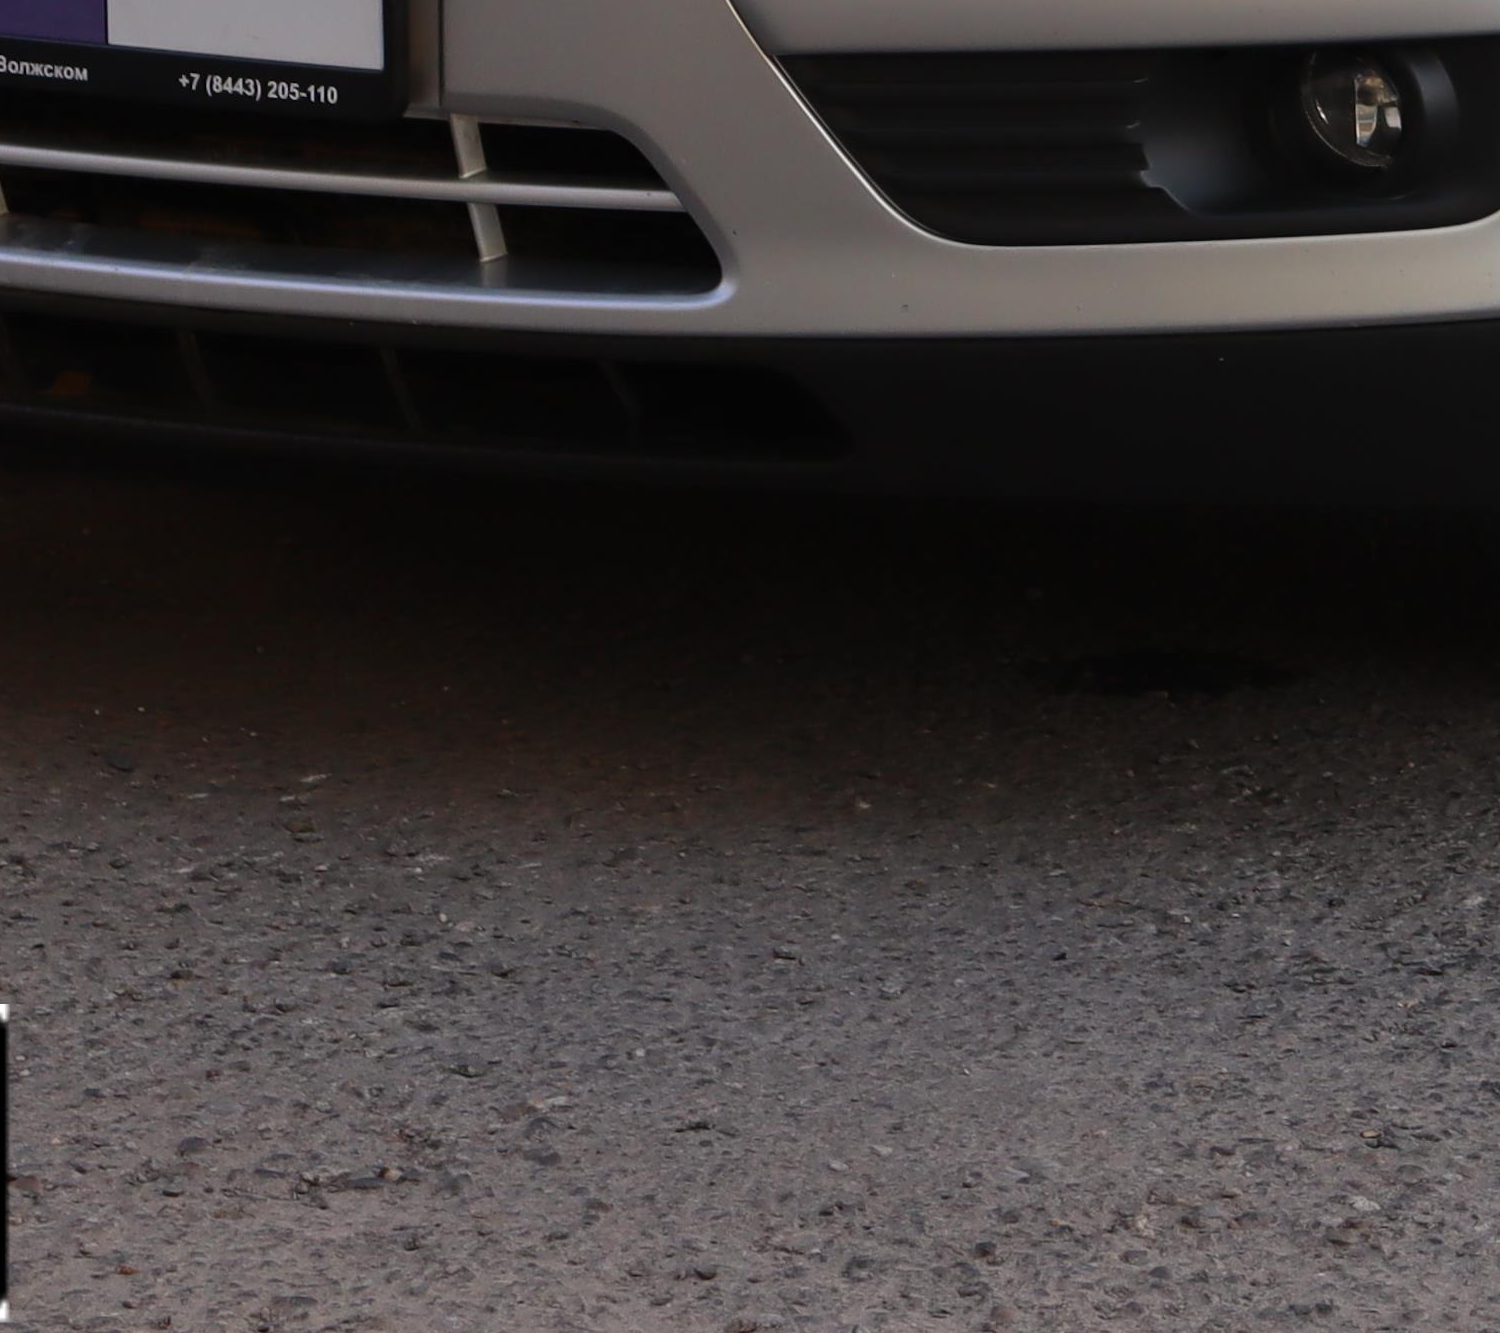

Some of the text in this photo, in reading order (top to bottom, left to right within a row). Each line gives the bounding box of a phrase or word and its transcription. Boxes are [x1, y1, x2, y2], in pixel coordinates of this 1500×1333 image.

[178, 73, 338, 104] +7 (8443) 205-110
